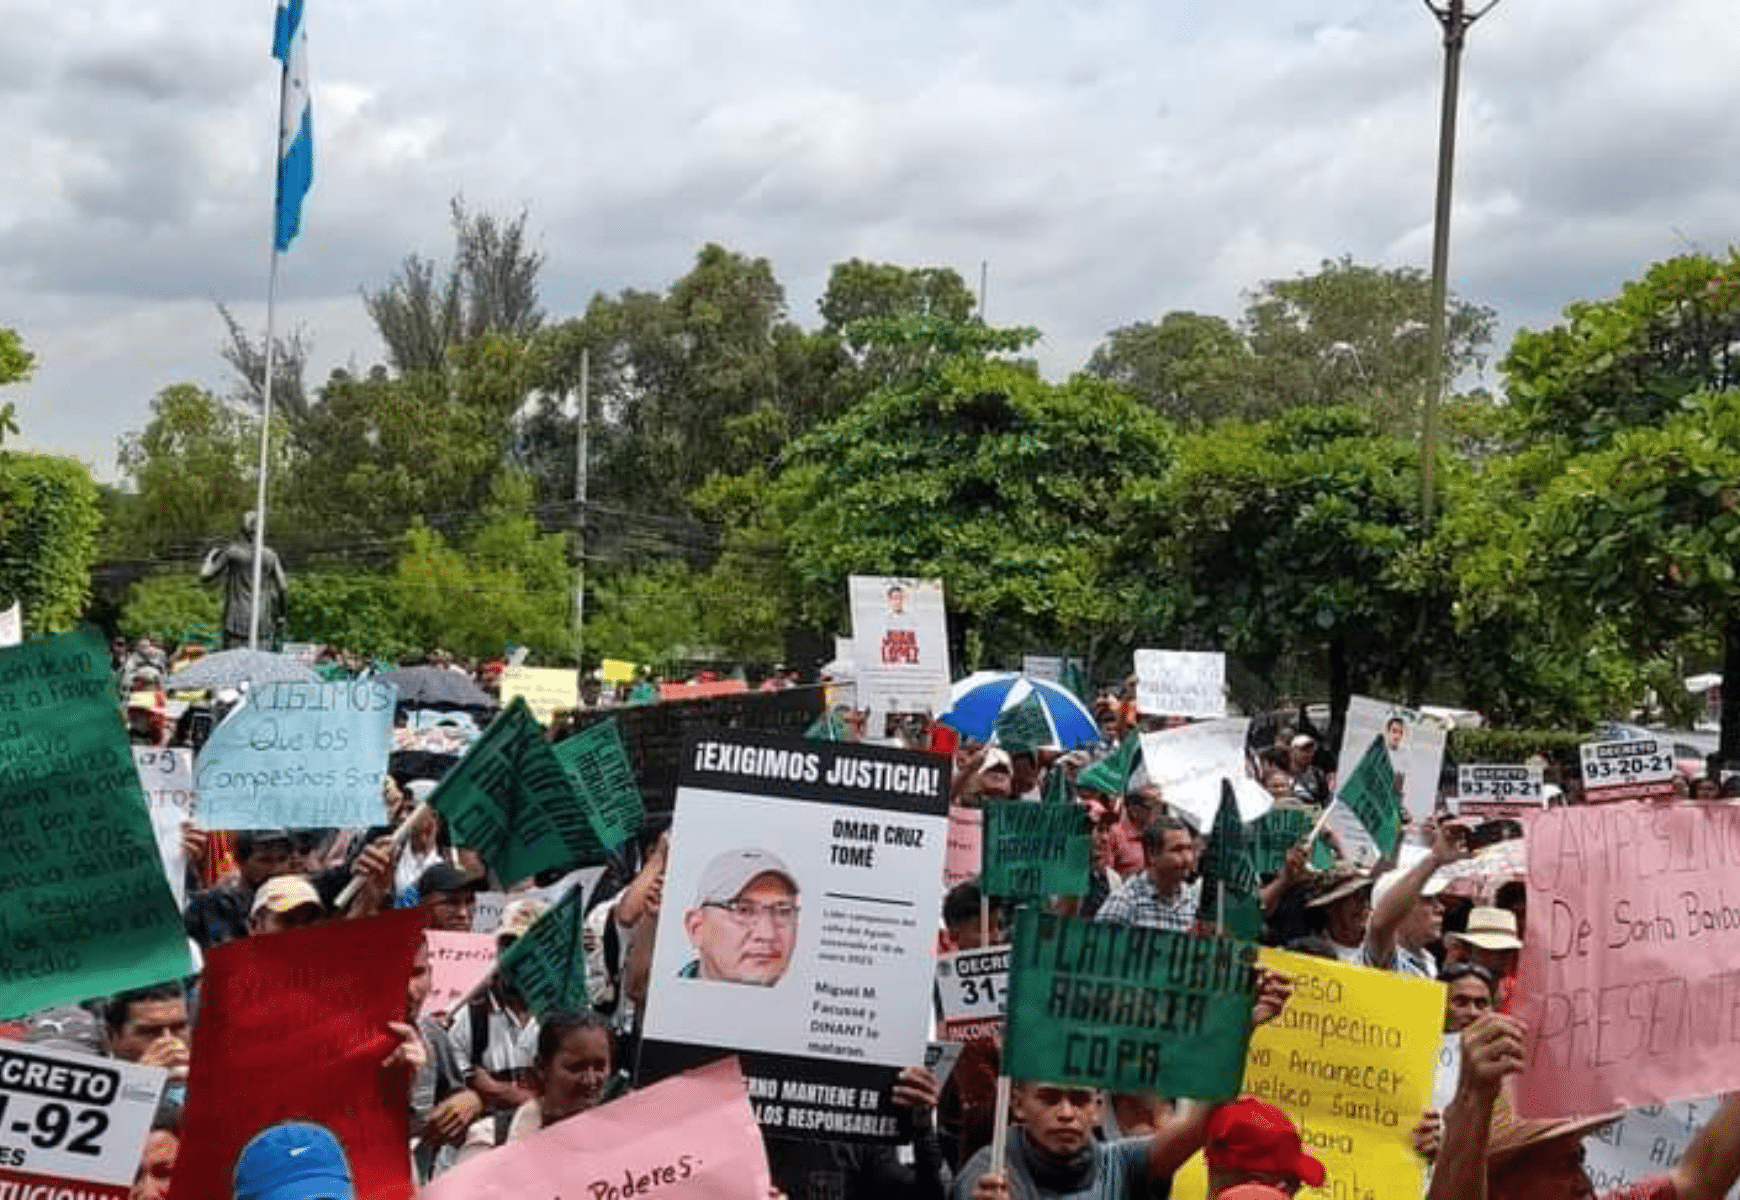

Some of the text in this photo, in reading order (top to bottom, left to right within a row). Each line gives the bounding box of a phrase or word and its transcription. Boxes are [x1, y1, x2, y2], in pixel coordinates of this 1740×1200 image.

[694, 742, 940, 797] ¡EXIGIMOS JUSTICIA!
[1586, 754, 1673, 779] 93-20-21
[1461, 780, 1542, 797] 93-20-21
[832, 819, 880, 843] OMAR
[884, 825, 924, 848] CRUZ
[1550, 897, 1594, 960] De
[810, 1020, 864, 1037] DINANT
[0, 1056, 112, 1099] CRETO
[1063, 1032, 1161, 1087] COPA
[1289, 1050, 1404, 1095] Amanecer
[781, 1080, 857, 1108] MANTIENE
[860, 1088, 880, 1110] EN
